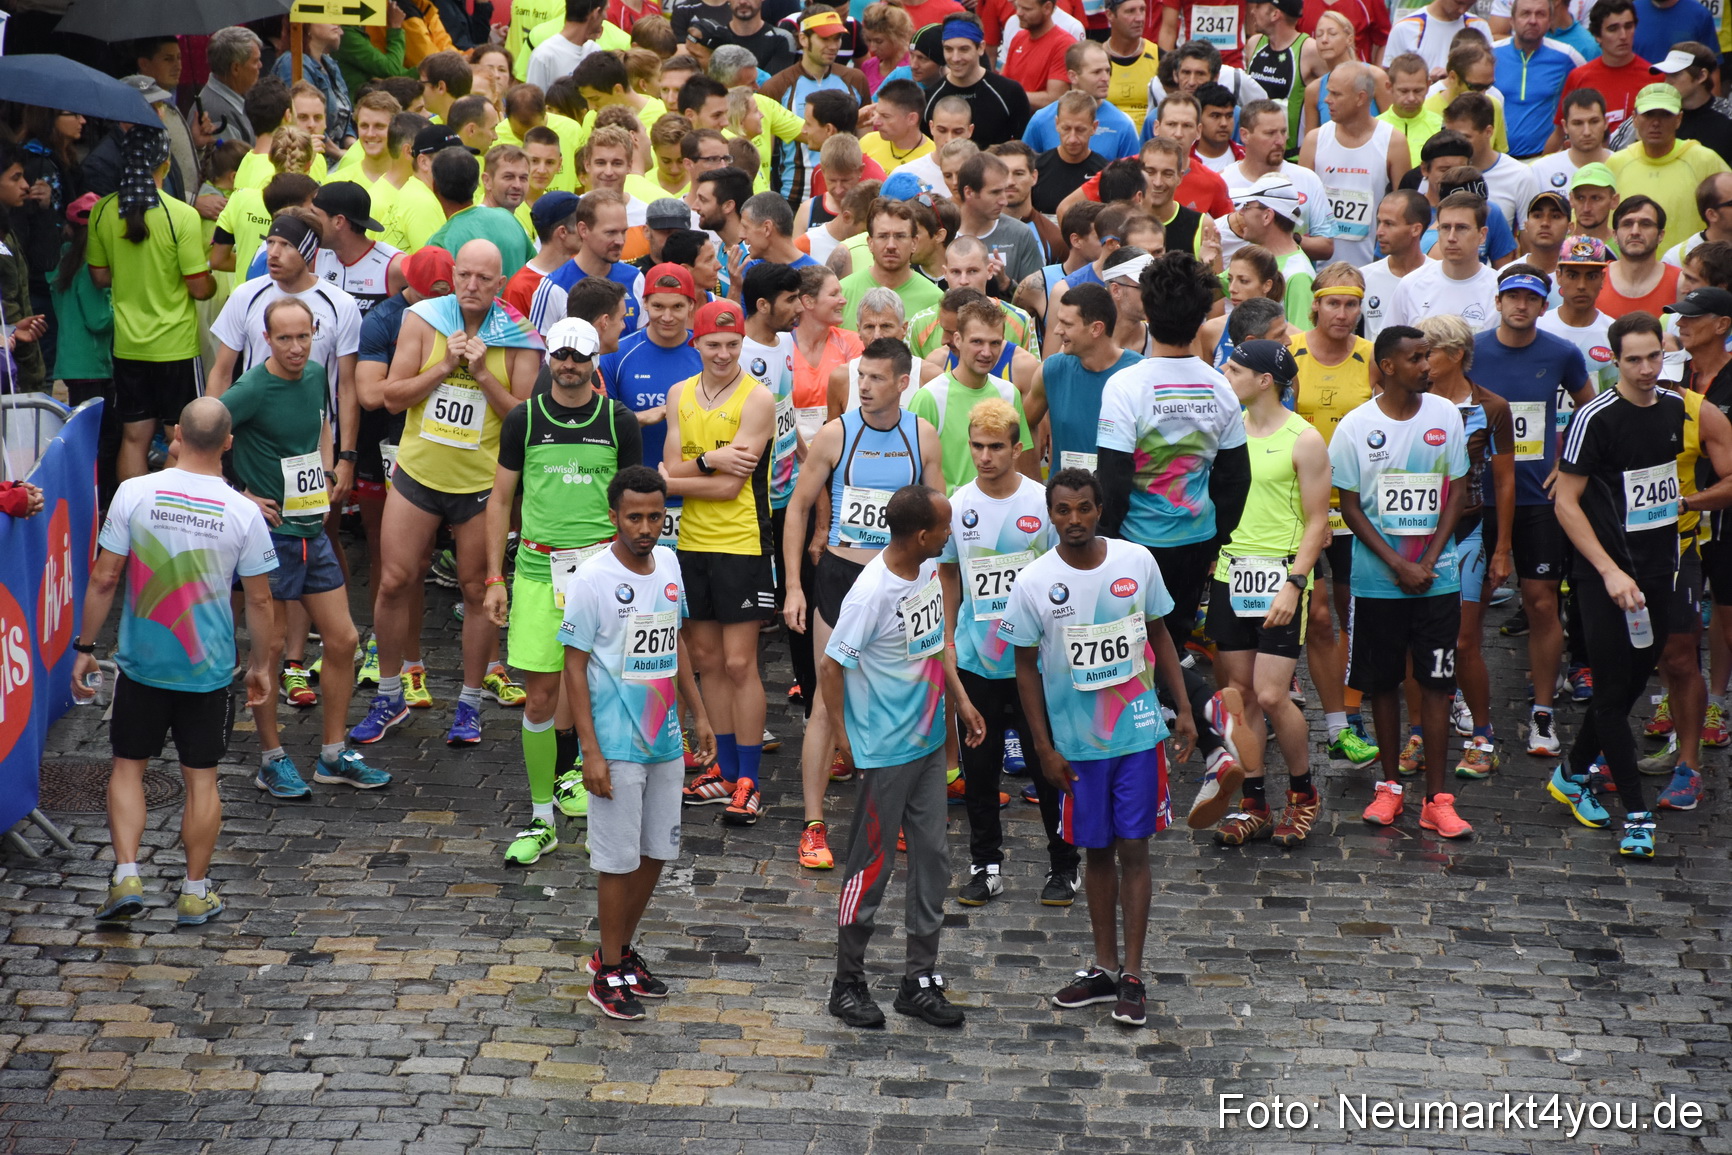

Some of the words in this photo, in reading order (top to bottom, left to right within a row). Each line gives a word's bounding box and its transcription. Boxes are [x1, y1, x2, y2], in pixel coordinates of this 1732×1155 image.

[1196, 16, 1235, 33] 2347
[1263, 65, 1277, 74] DAV
[636, 392, 666, 407] SYS
[434, 397, 474, 426] 500
[1152, 401, 1219, 416] NeuerMarkt
[1514, 416, 1527, 438] 9
[1368, 450, 1390, 460] PARTL
[543, 464, 573, 474] SoWiso
[297, 466, 325, 493] 620
[1408, 475, 1438, 484] BOCK
[1632, 476, 1677, 508] 2460
[1385, 488, 1438, 512] 2679
[1648, 507, 1667, 520] David
[150, 509, 226, 533] NeuerMarkt
[1019, 519, 1039, 530] Hervis
[1398, 516, 1428, 527] Mohad
[858, 530, 886, 545] Marco
[995, 552, 1031, 566] BOCK
[1113, 582, 1136, 593] Hervis
[1233, 570, 1281, 593] 2002
[618, 606, 639, 614] PARTL
[1052, 605, 1075, 616] PARTL
[1243, 599, 1266, 609] Stefan
[910, 593, 943, 638] 2722
[1054, 610, 1077, 620] Neumarkt
[1092, 622, 1126, 636] BOCK
[633, 625, 675, 654] 2678
[1070, 635, 1130, 667] 2766
[633, 658, 658, 671] Abdul
[659, 657, 674, 669] Basit
[1430, 647, 1456, 679] 13
[1085, 666, 1118, 683] Ahmad
[1131, 699, 1150, 713] 17.
